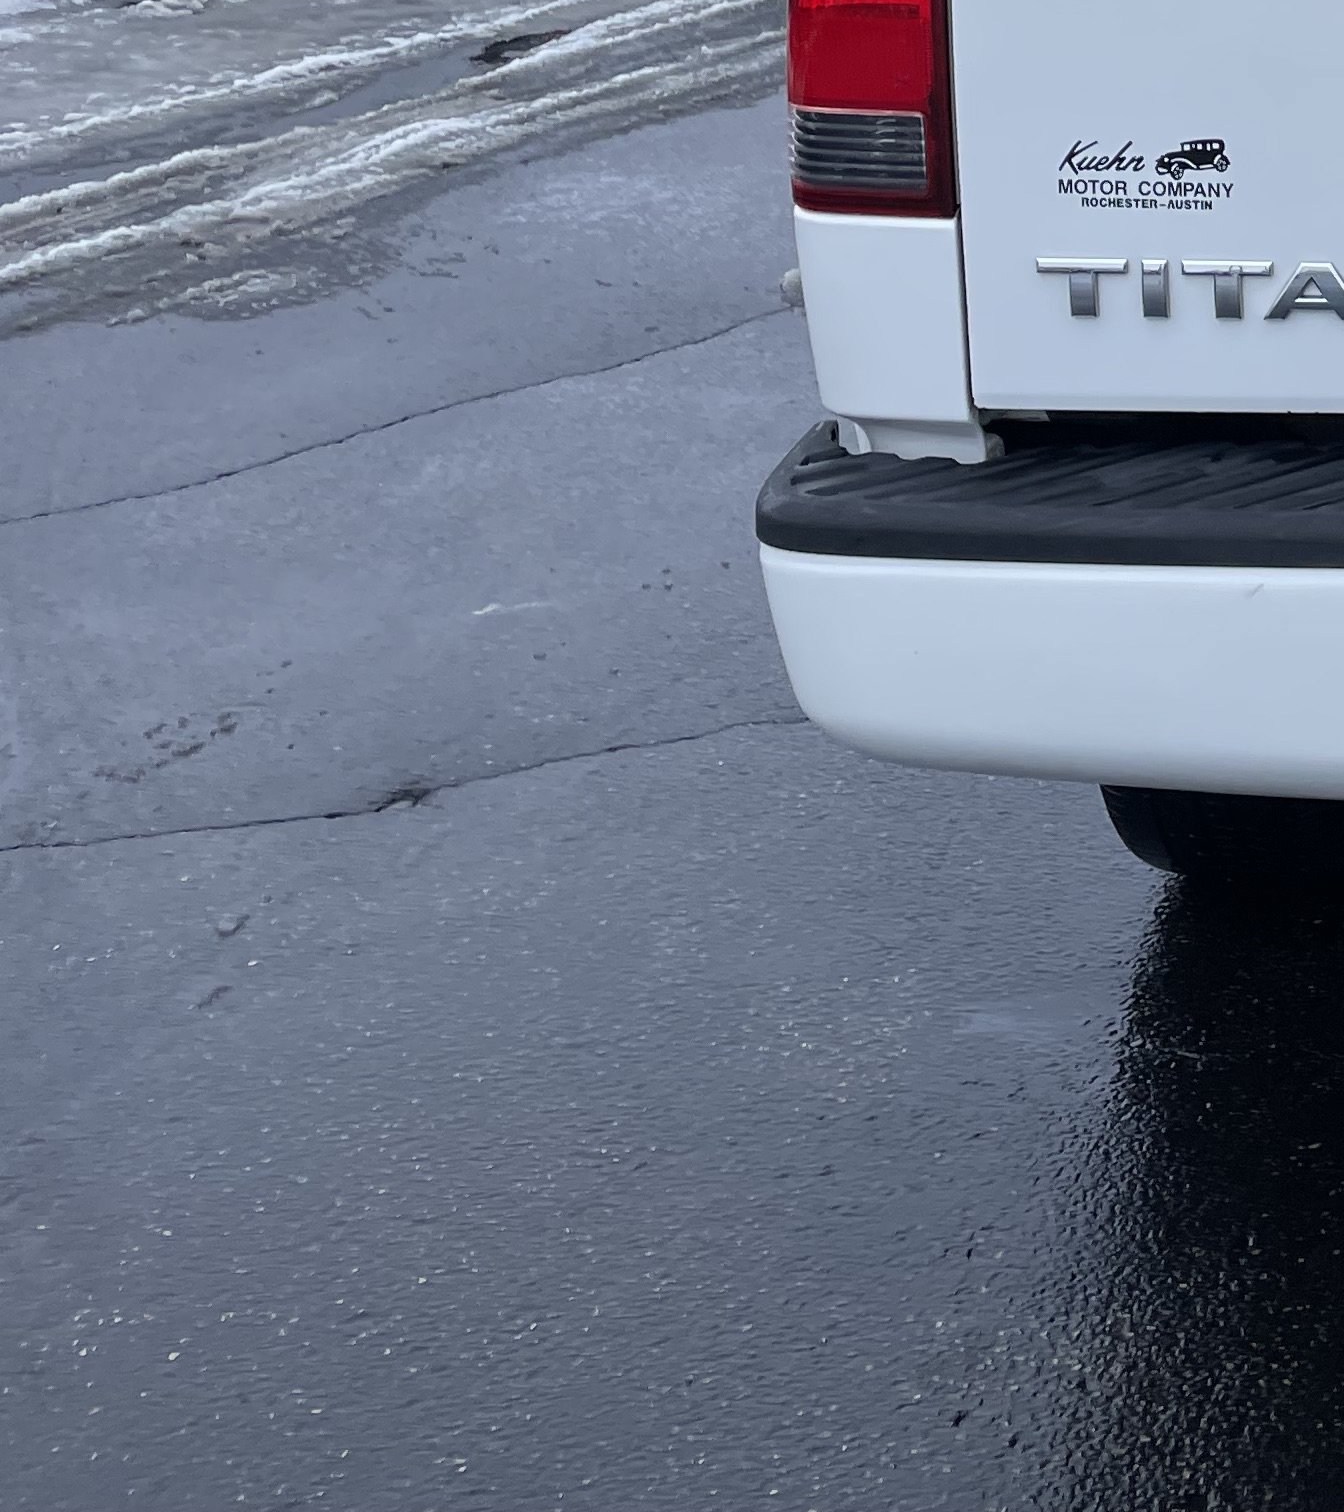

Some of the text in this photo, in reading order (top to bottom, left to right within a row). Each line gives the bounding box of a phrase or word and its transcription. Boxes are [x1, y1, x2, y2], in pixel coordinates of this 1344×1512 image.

[1058, 139, 1146, 176] Kuehn
[1058, 179, 1234, 198] MOTOR COMPANY
